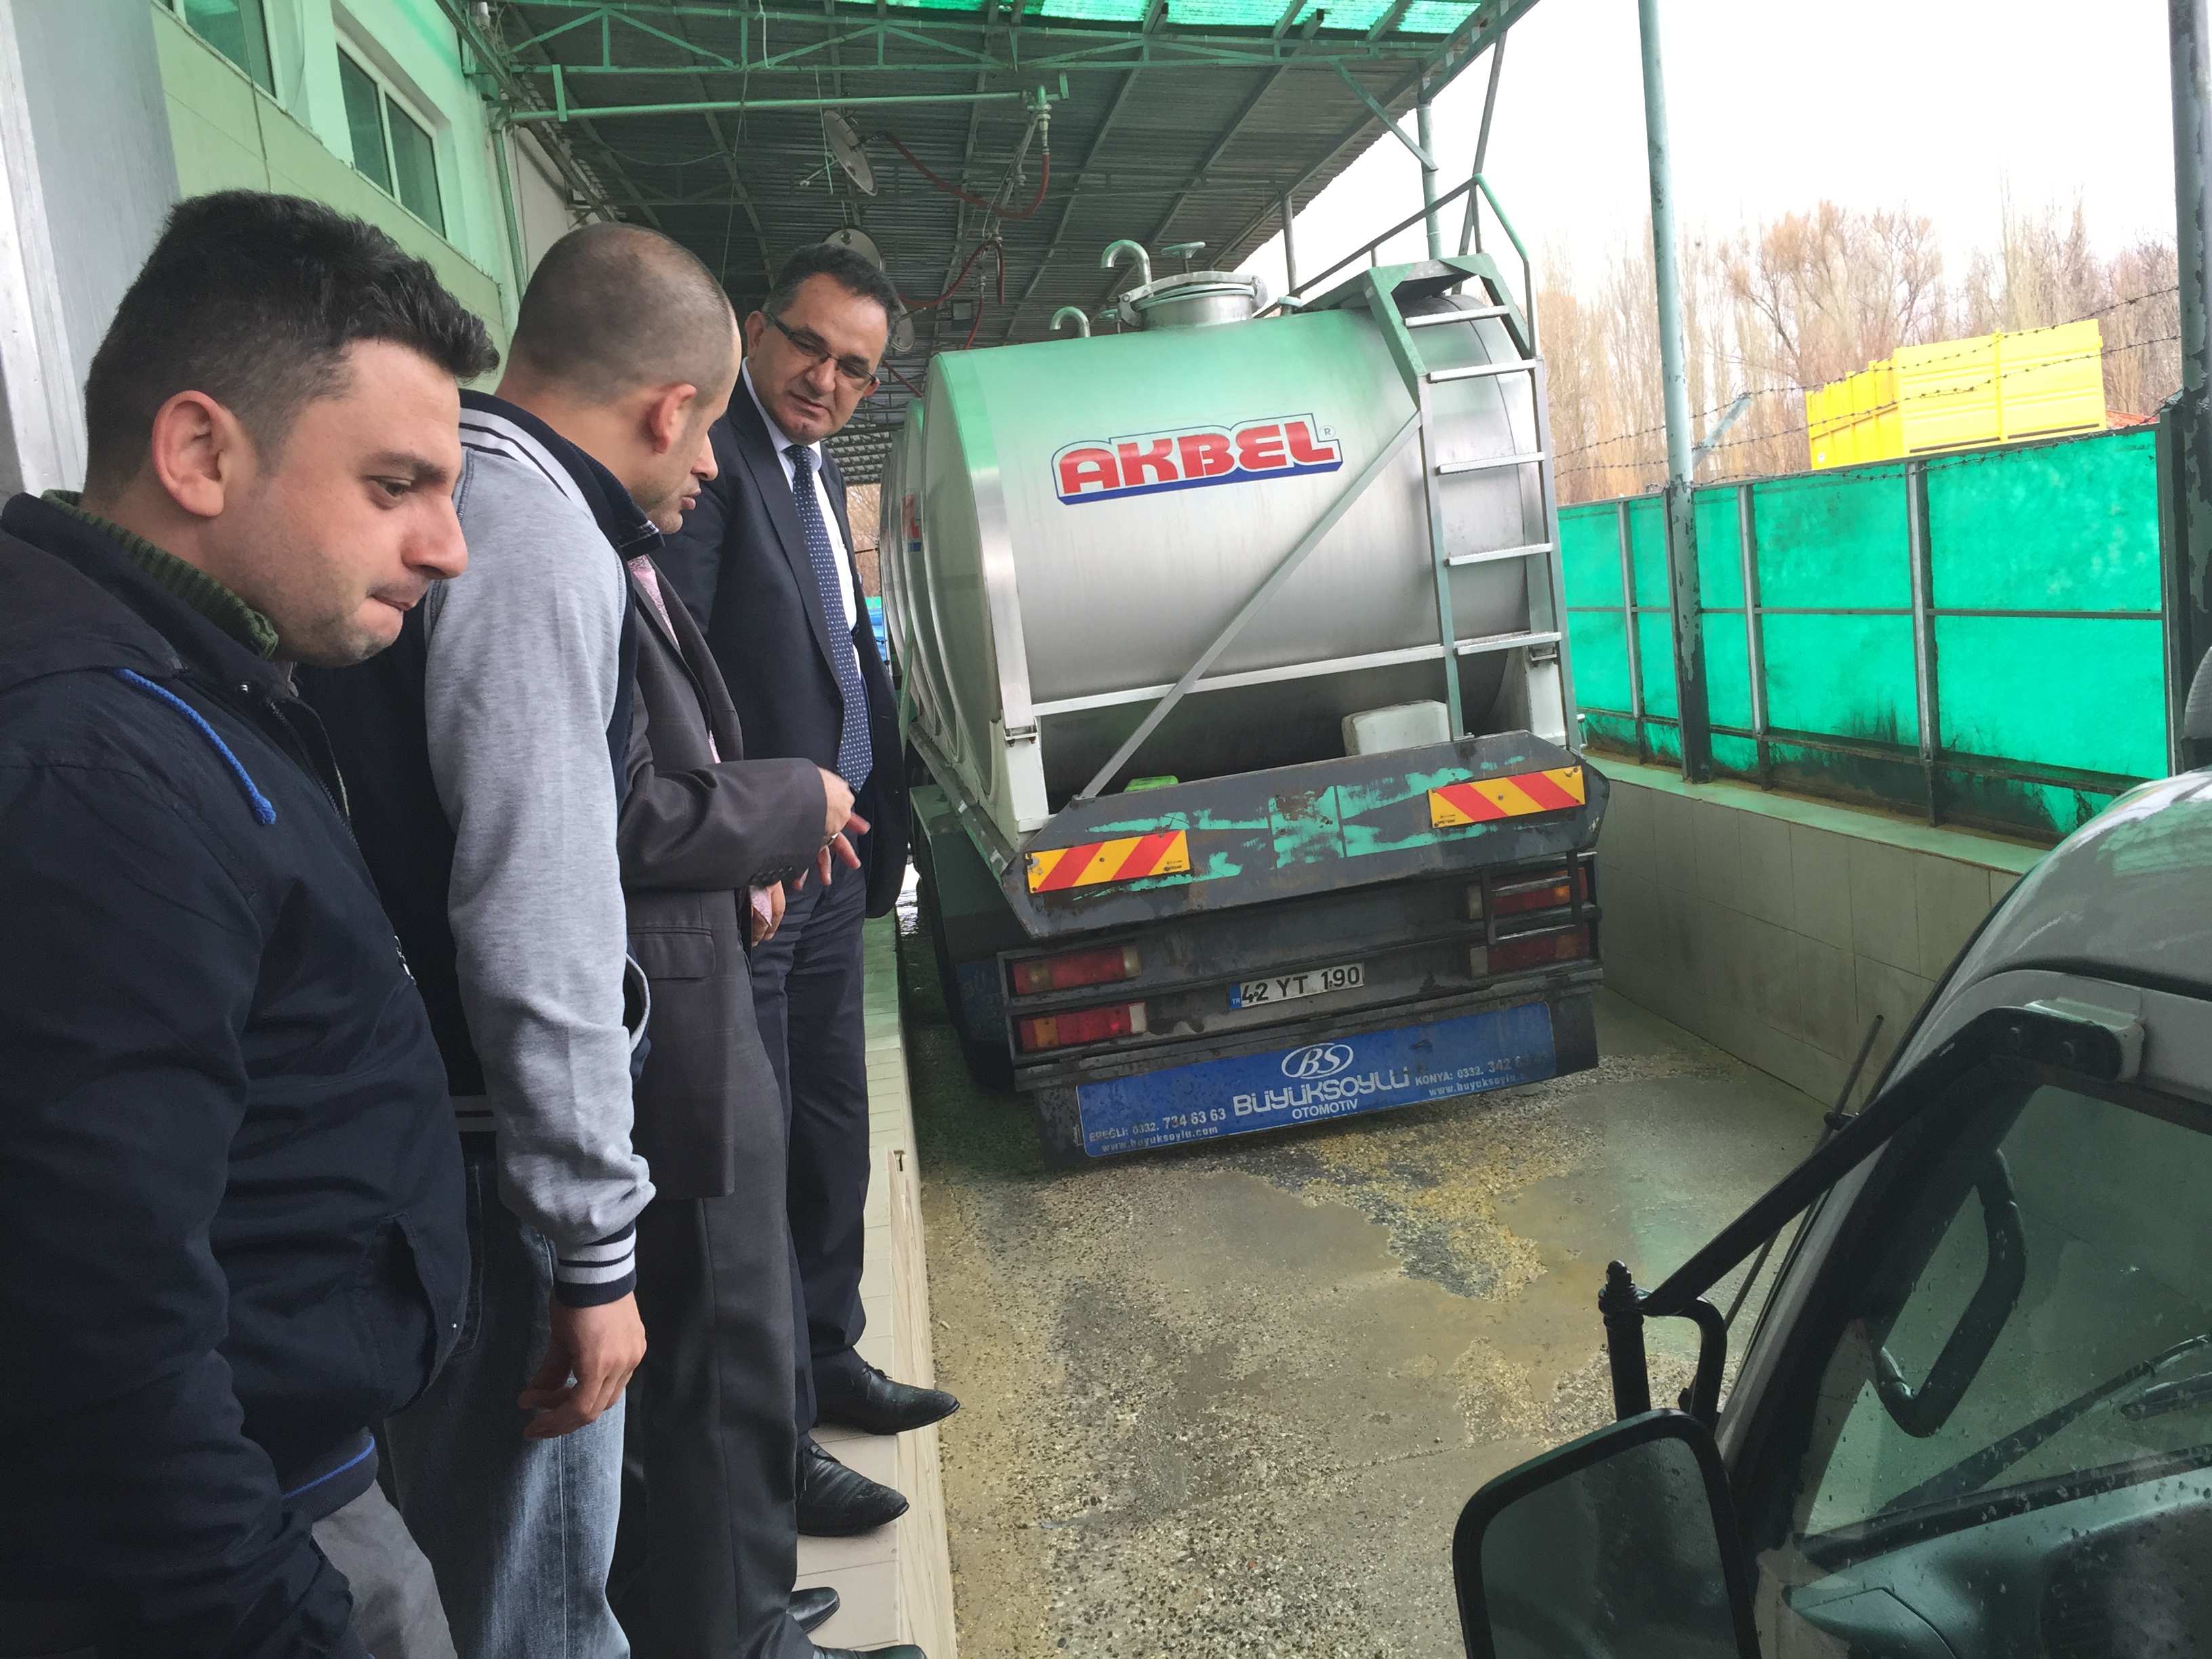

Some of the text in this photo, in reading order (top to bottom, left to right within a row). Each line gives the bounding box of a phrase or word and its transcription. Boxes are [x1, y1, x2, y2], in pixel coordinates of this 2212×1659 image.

[1059, 421, 1335, 495] AKBEL
[1242, 966, 1360, 1003] 42 YT 190
[1290, 1045, 1347, 1078] BS
[1414, 1071, 1454, 1086] KONYA:
[1487, 1057, 1512, 1073] 342
[1162, 1113, 1187, 1130] 734
[1190, 1111, 1207, 1125] 63
[1210, 1107, 1227, 1122] 63
